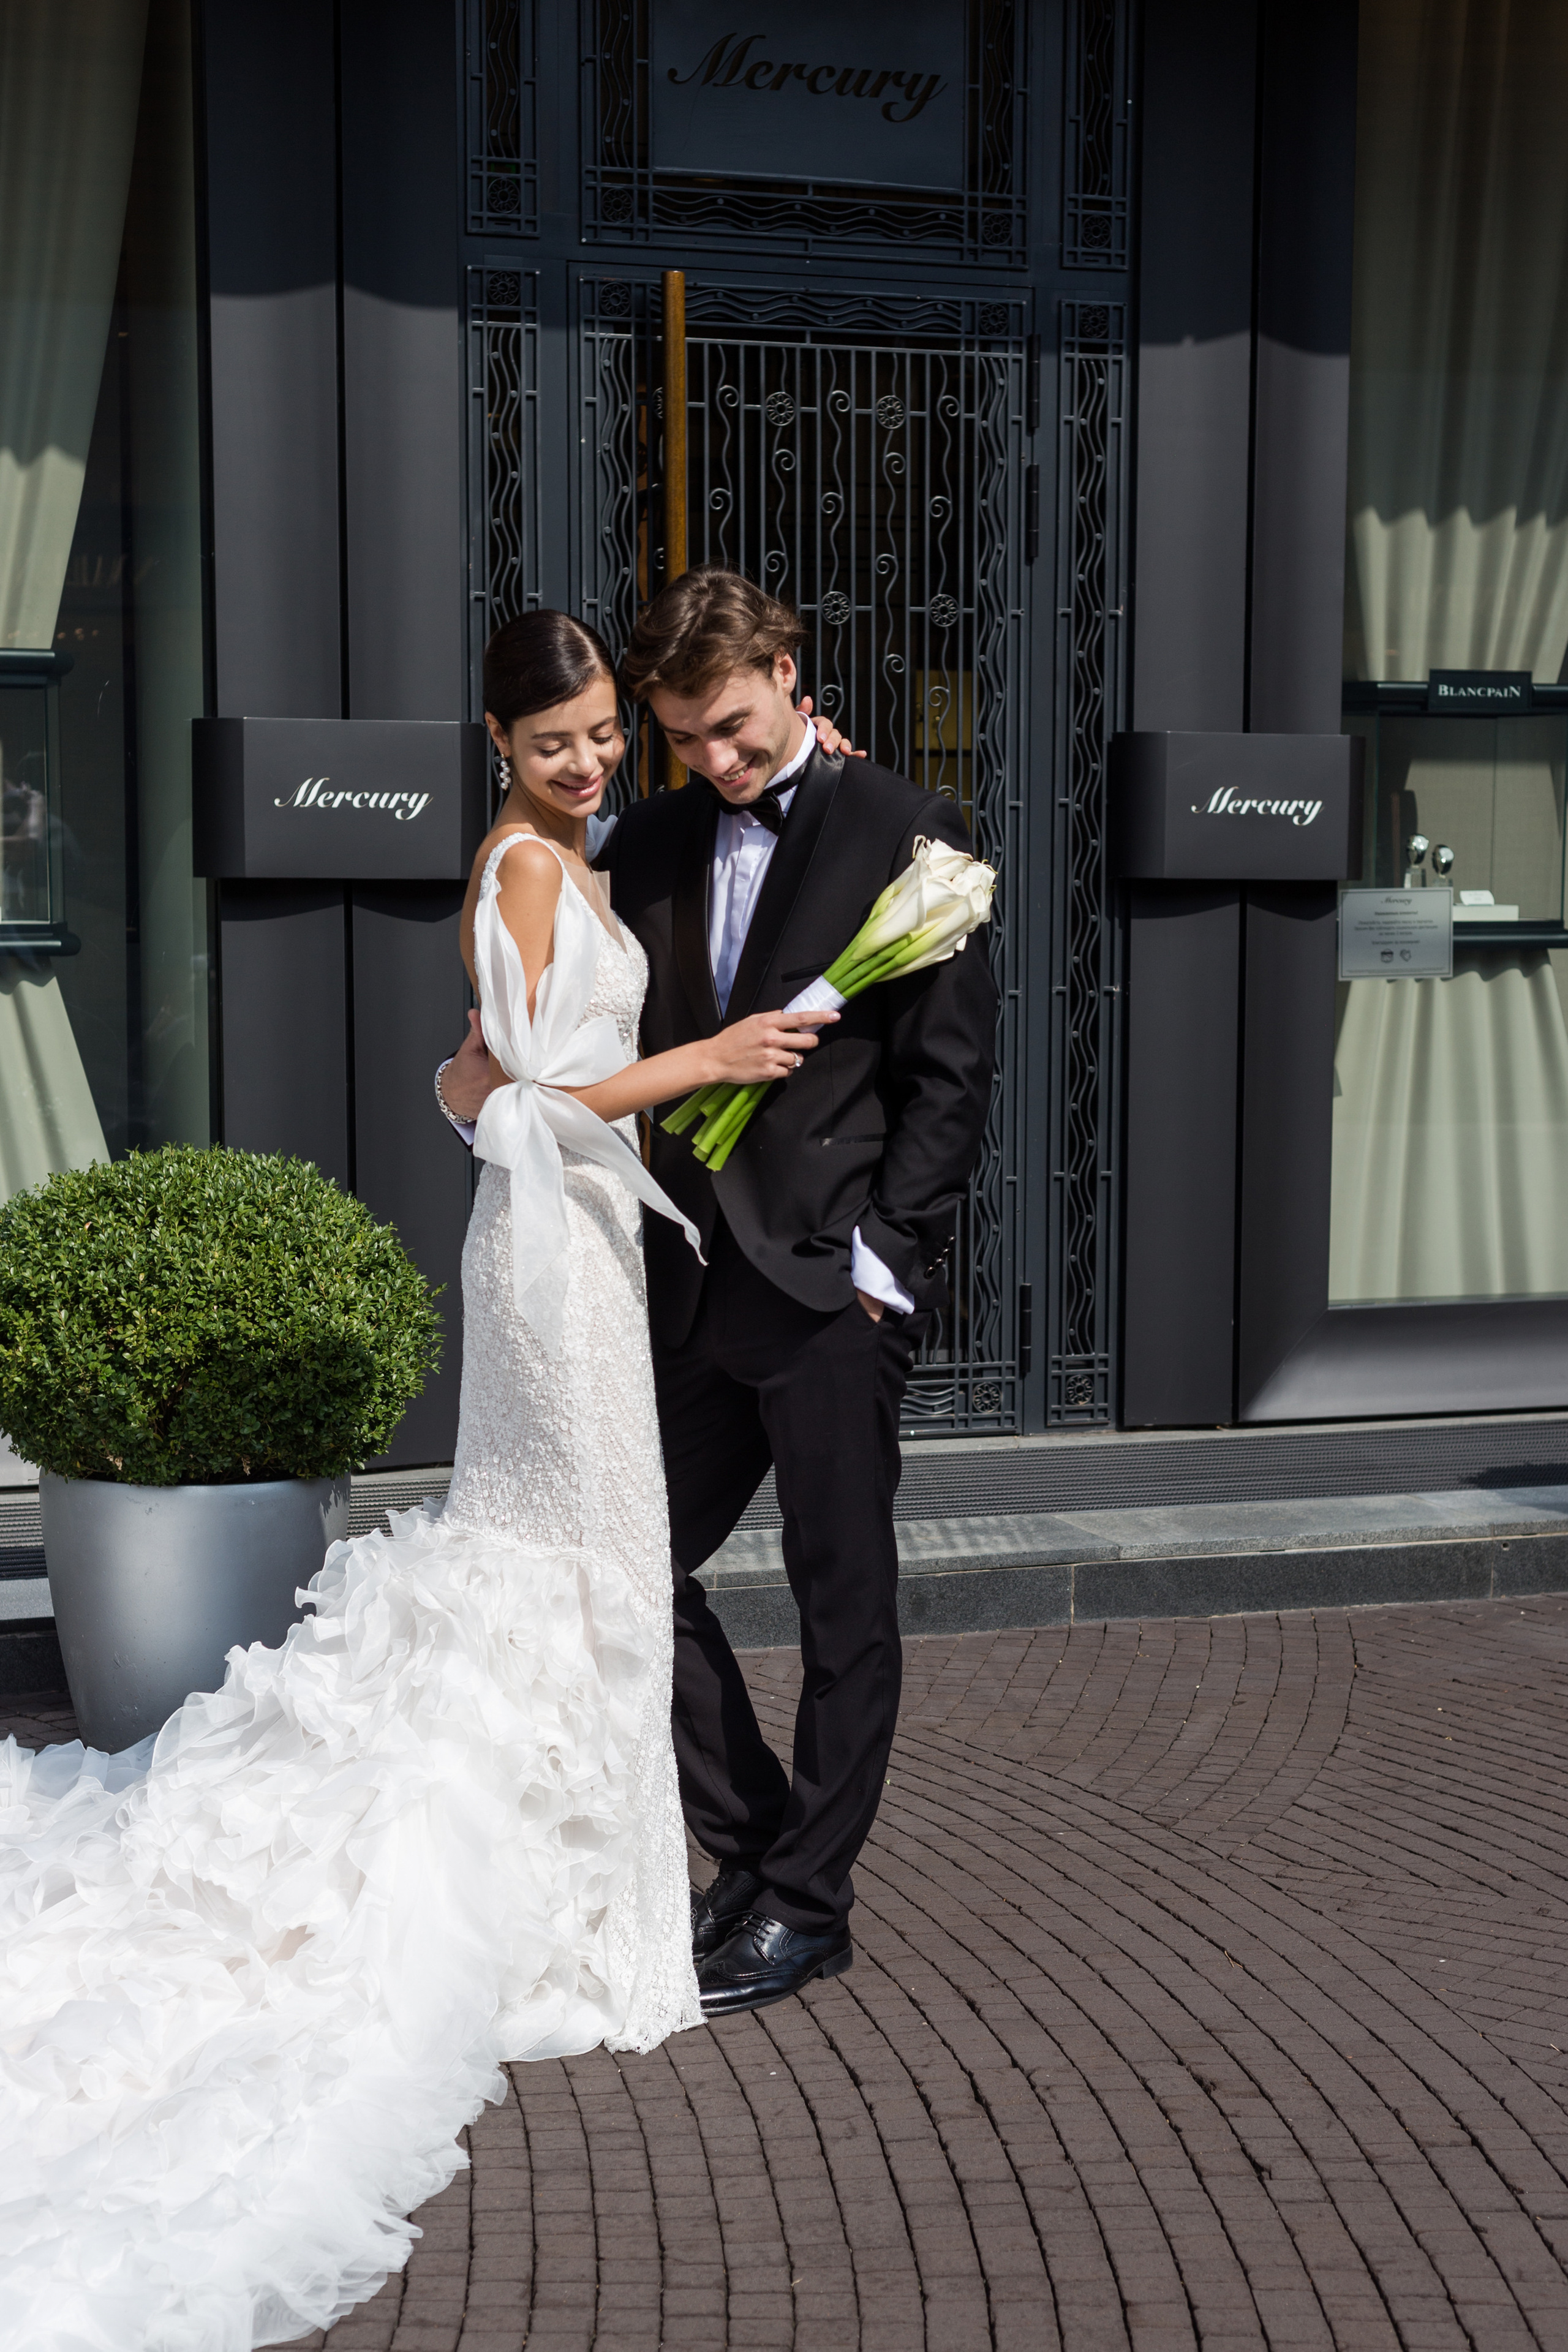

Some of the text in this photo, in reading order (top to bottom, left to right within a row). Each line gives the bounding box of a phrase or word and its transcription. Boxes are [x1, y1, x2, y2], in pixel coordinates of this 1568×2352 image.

[668, 32, 948, 123] Mercury
[1438, 684, 1521, 698] BLANCPAIN
[274, 777, 434, 820] Mercury
[1191, 786, 1325, 826] Mercury
[1381, 896, 1412, 905] Mercury
